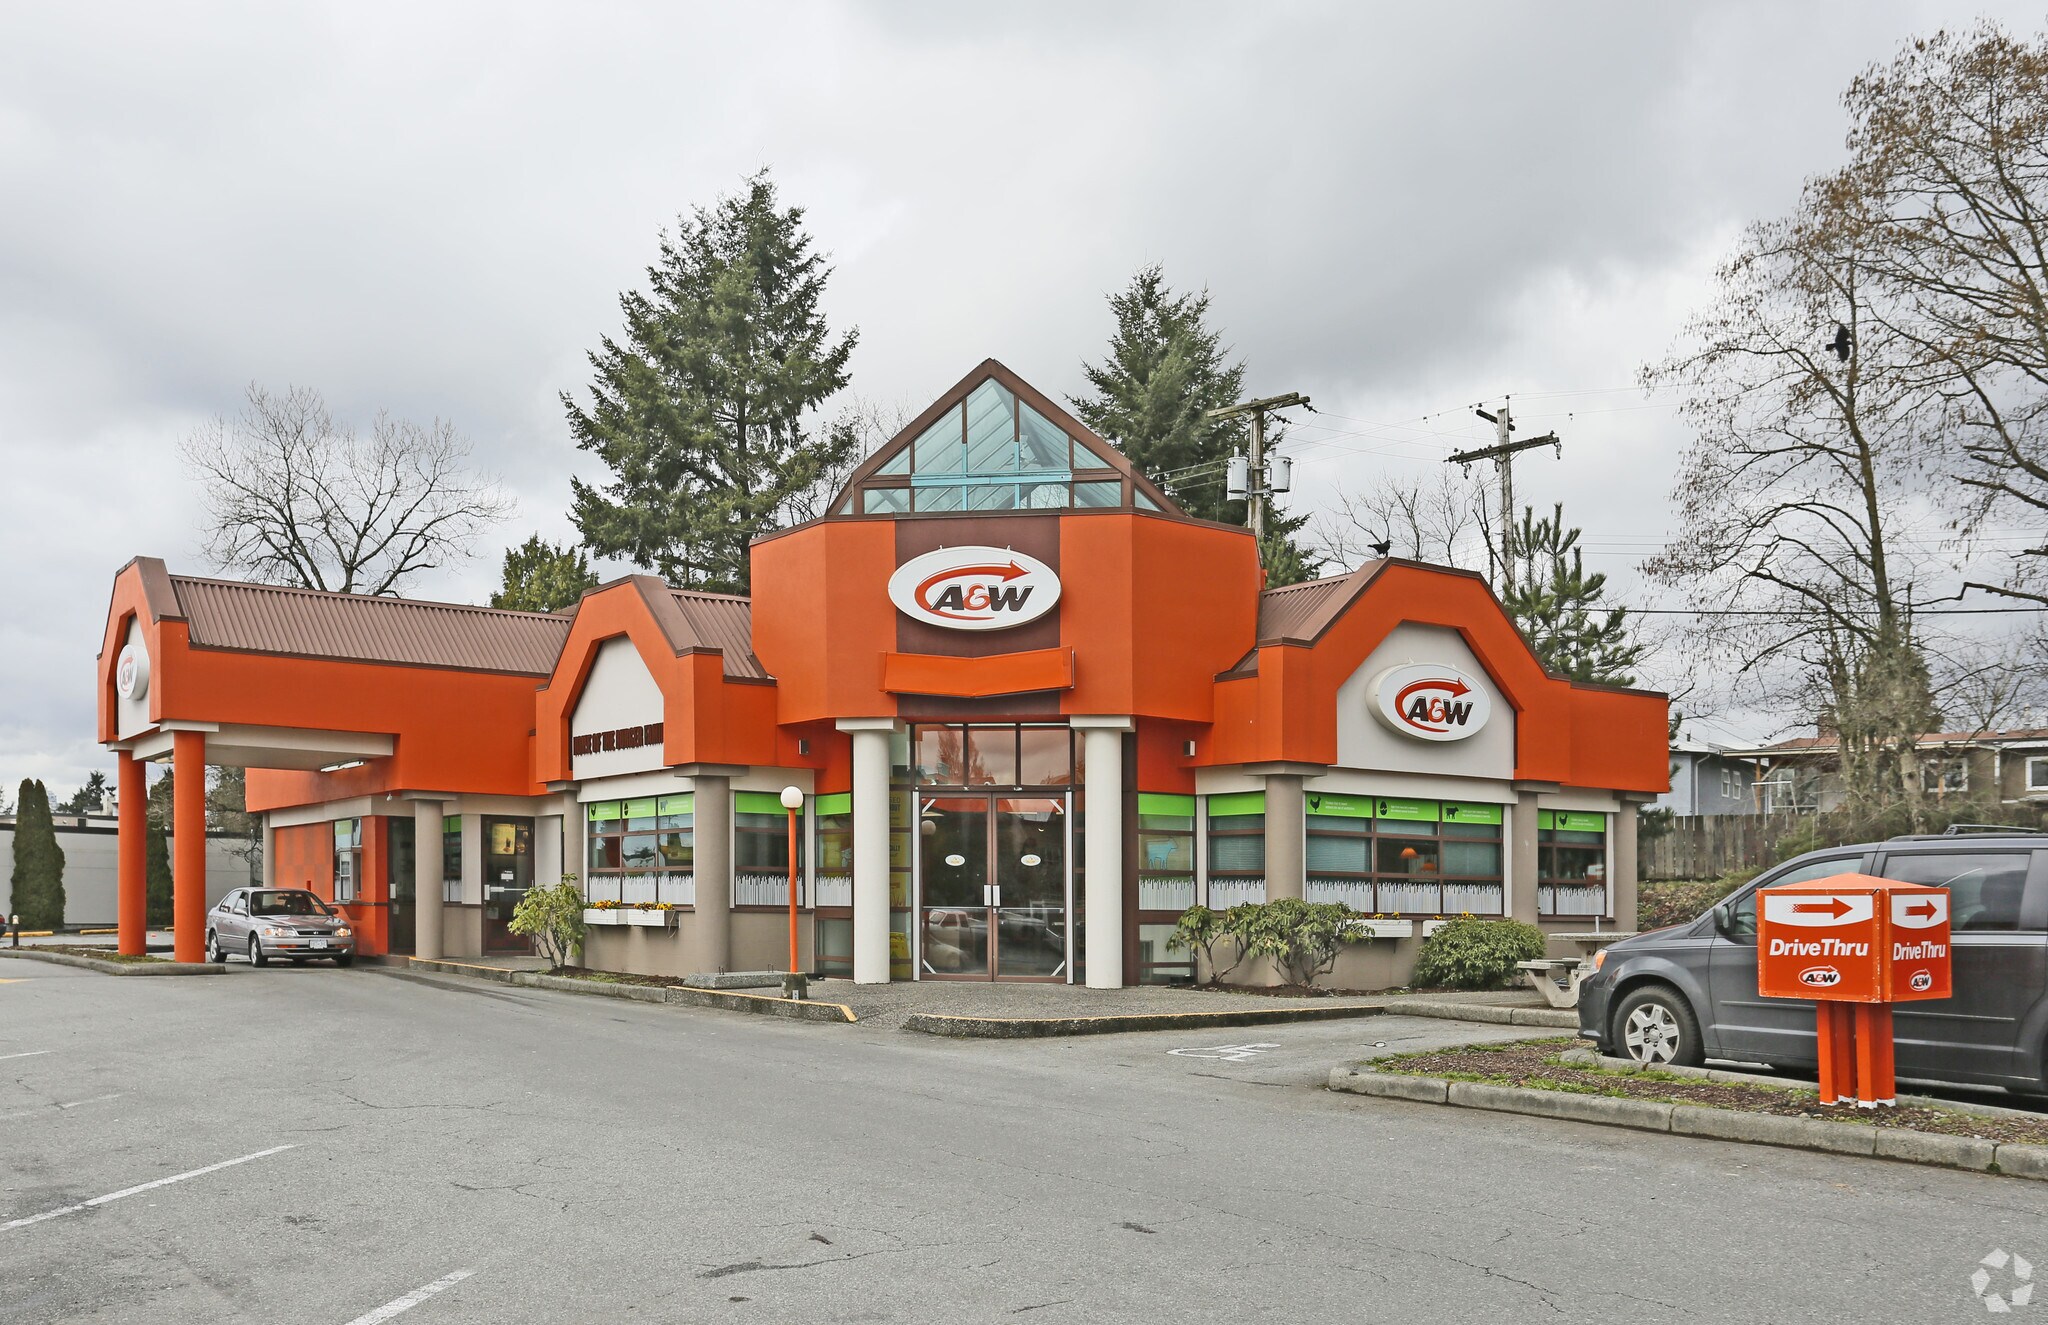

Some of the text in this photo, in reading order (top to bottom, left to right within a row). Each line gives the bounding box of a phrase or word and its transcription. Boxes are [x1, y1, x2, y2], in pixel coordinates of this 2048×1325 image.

[929, 583, 1035, 612] A&W
[1406, 696, 1474, 726] A&W
[1769, 938, 1869, 957] DriveThru
[1893, 940, 1946, 961] DriveThru
[1803, 971, 1838, 983] A&W
[1913, 975, 1930, 988] A&W
